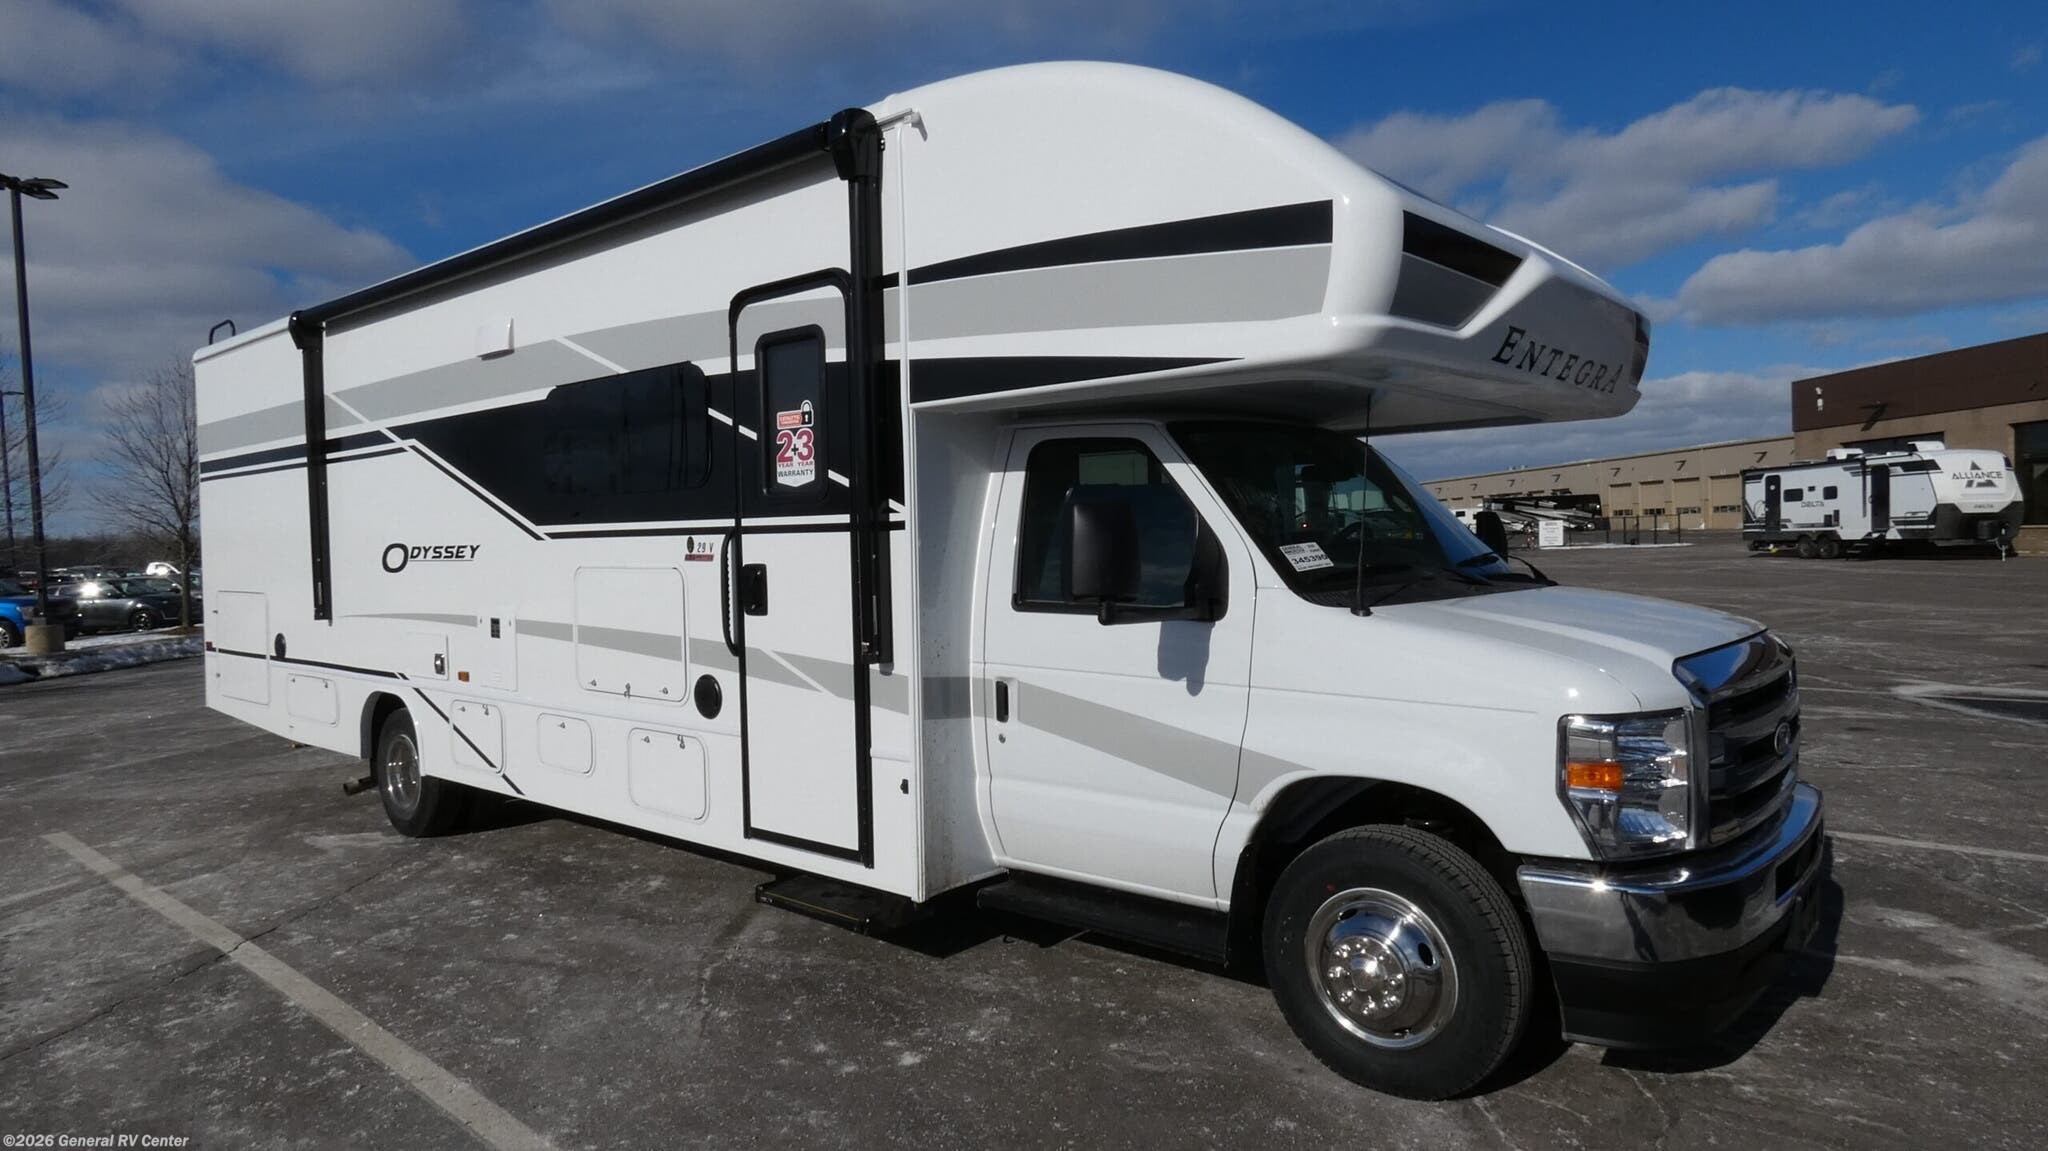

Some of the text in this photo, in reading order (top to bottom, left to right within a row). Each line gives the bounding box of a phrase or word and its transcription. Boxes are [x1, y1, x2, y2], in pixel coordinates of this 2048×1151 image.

[1491, 325, 1624, 393] ENTEGRA
[778, 469, 814, 477] WARRANTY
[1952, 471, 2004, 480] ALLIANCE
[382, 543, 480, 573] ODYSSEY
